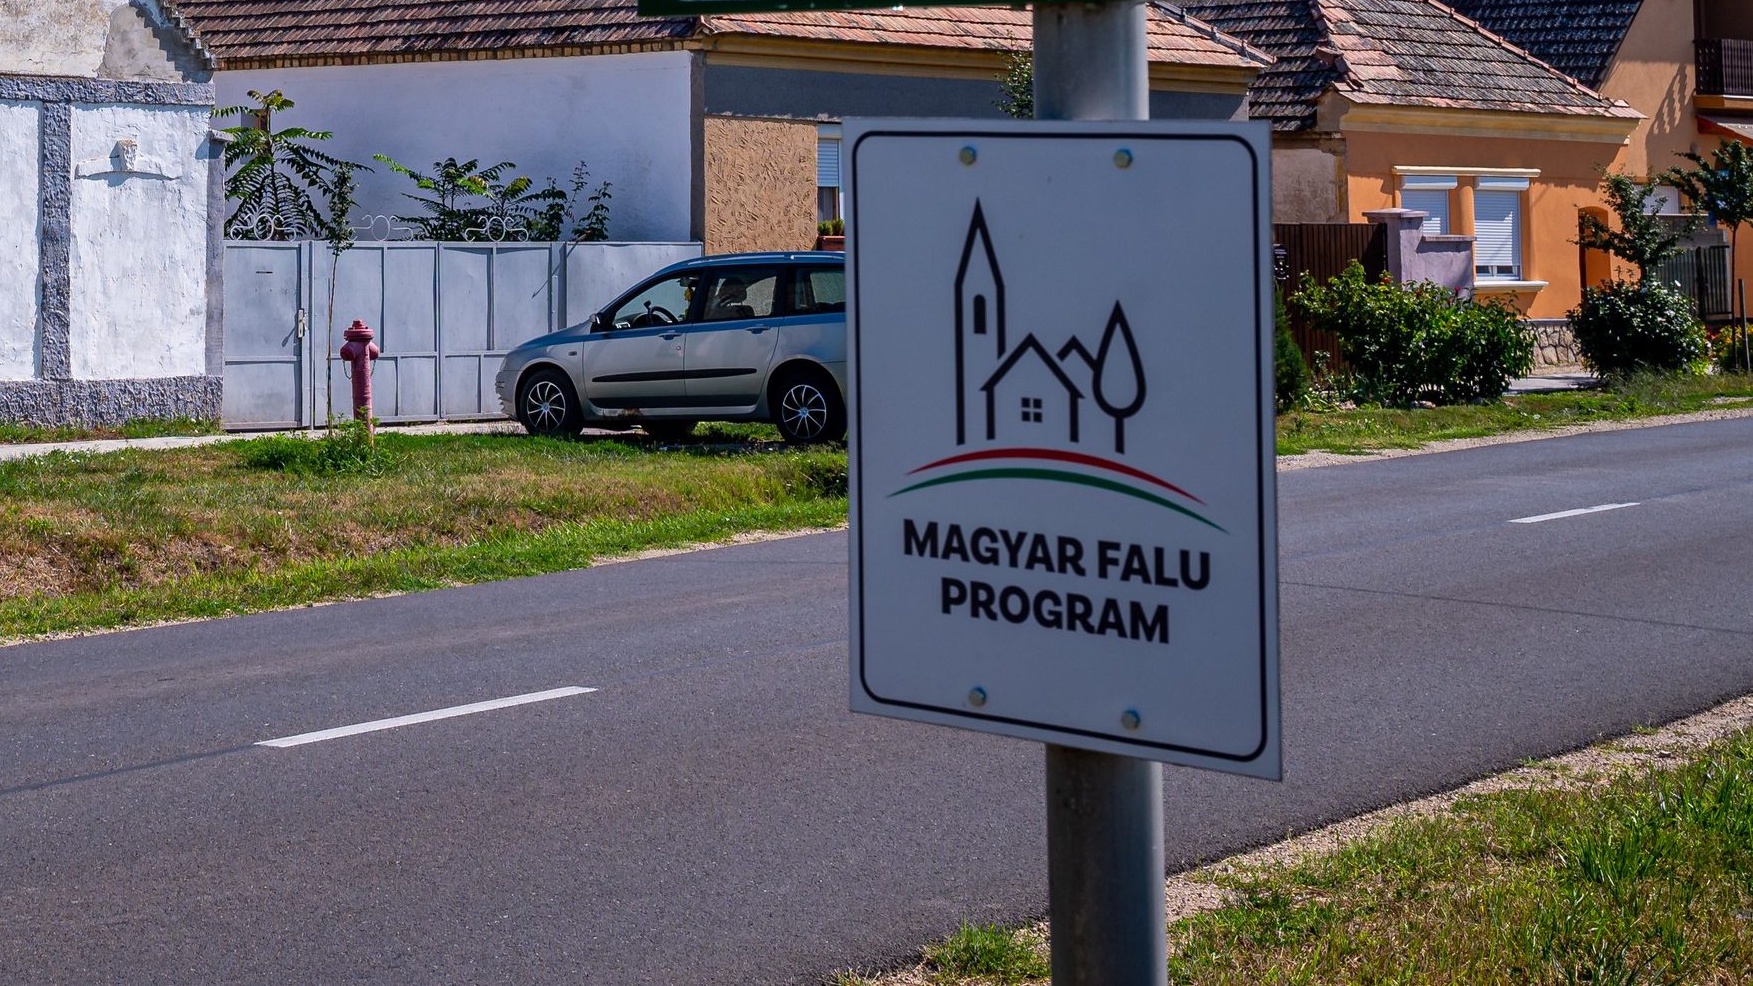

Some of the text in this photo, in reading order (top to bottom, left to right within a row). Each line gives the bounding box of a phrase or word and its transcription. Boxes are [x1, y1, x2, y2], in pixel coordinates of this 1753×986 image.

[903, 519, 1211, 591] MAGYAR FALU
[941, 577, 1170, 644] PROGRAM
